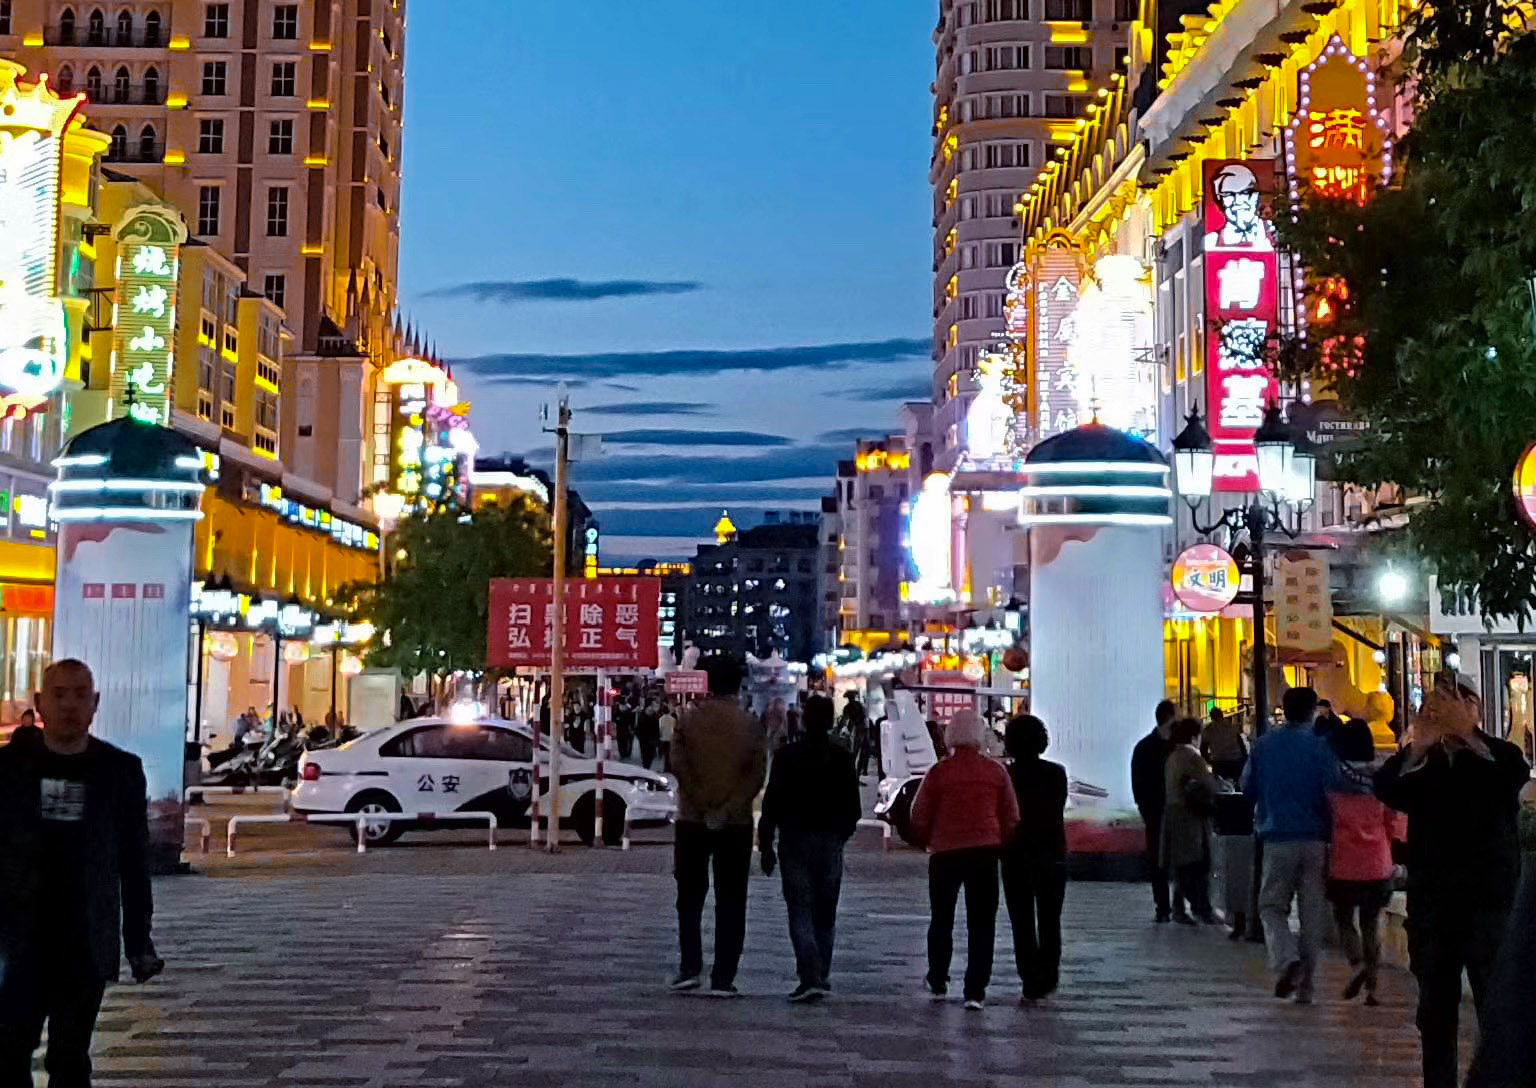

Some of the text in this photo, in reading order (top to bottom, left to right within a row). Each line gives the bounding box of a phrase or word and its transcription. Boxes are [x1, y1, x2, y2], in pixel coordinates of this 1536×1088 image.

[1217, 258, 1269, 428] 肯德基
[1189, 569, 1227, 591] 文明
[509, 603, 639, 625] 扫黑除恶
[508, 627, 639, 649] 弘扬正气
[417, 774, 460, 794] 公安
